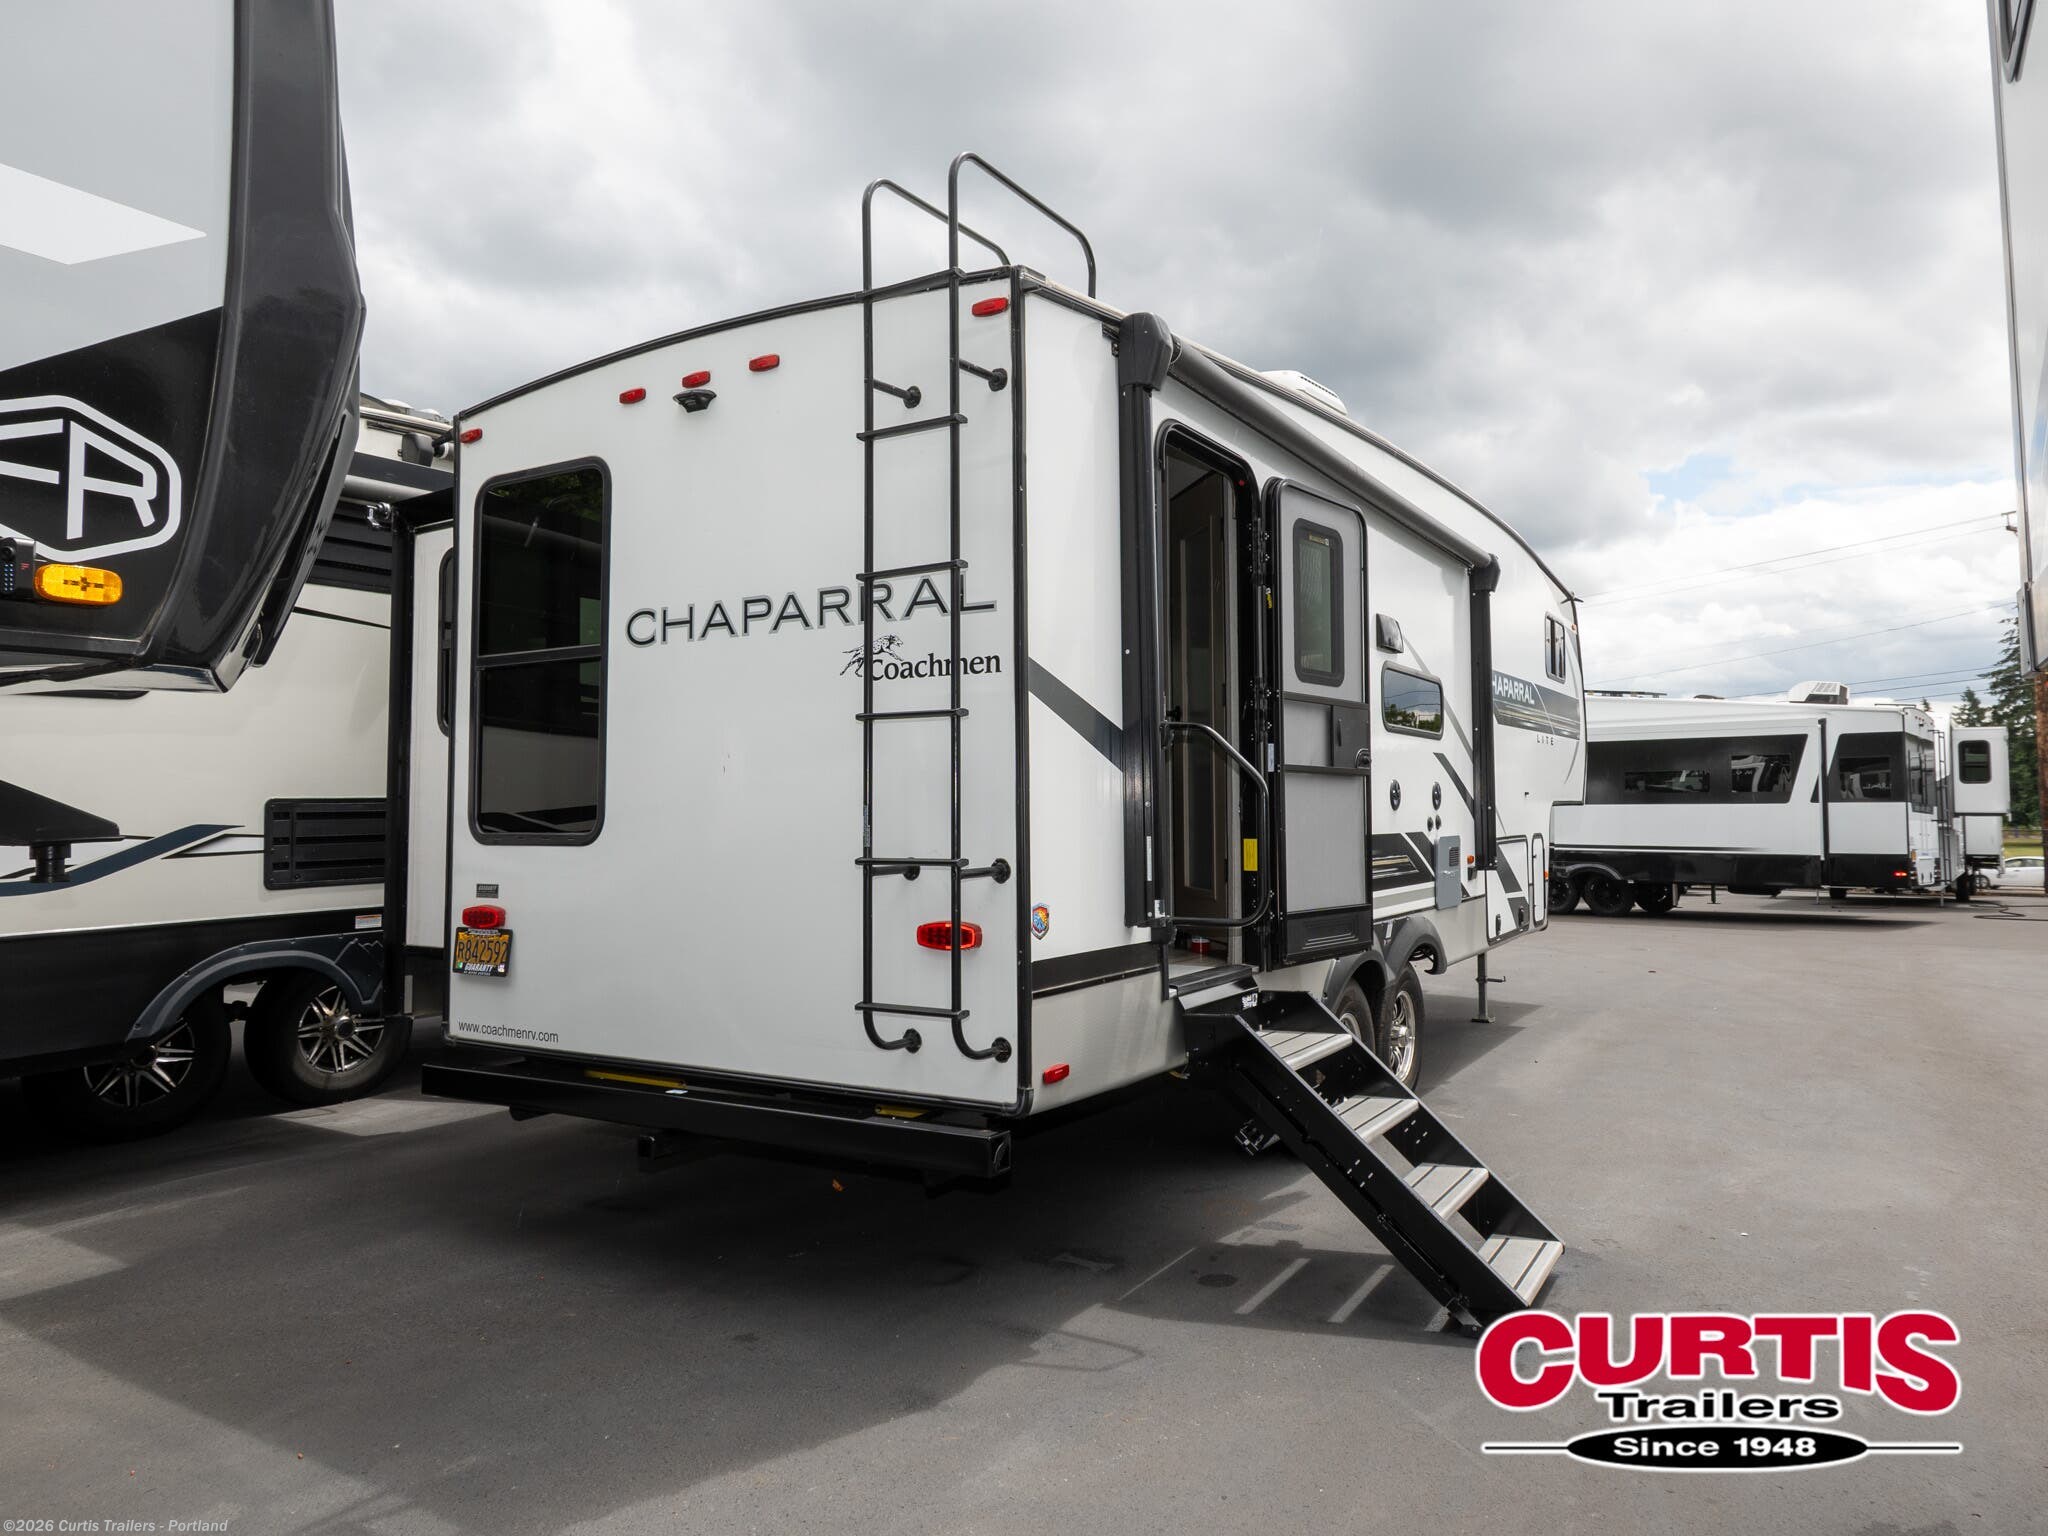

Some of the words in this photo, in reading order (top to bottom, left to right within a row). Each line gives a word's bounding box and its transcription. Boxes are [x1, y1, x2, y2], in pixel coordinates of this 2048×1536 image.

[625, 572, 997, 648] CHAPARRAL
[869, 653, 1002, 682] Coachmen
[1492, 674, 1535, 704] HAPARRAL
[1536, 735, 1555, 746] LITE
[458, 1021, 559, 1043] www.coachmenrv.com
